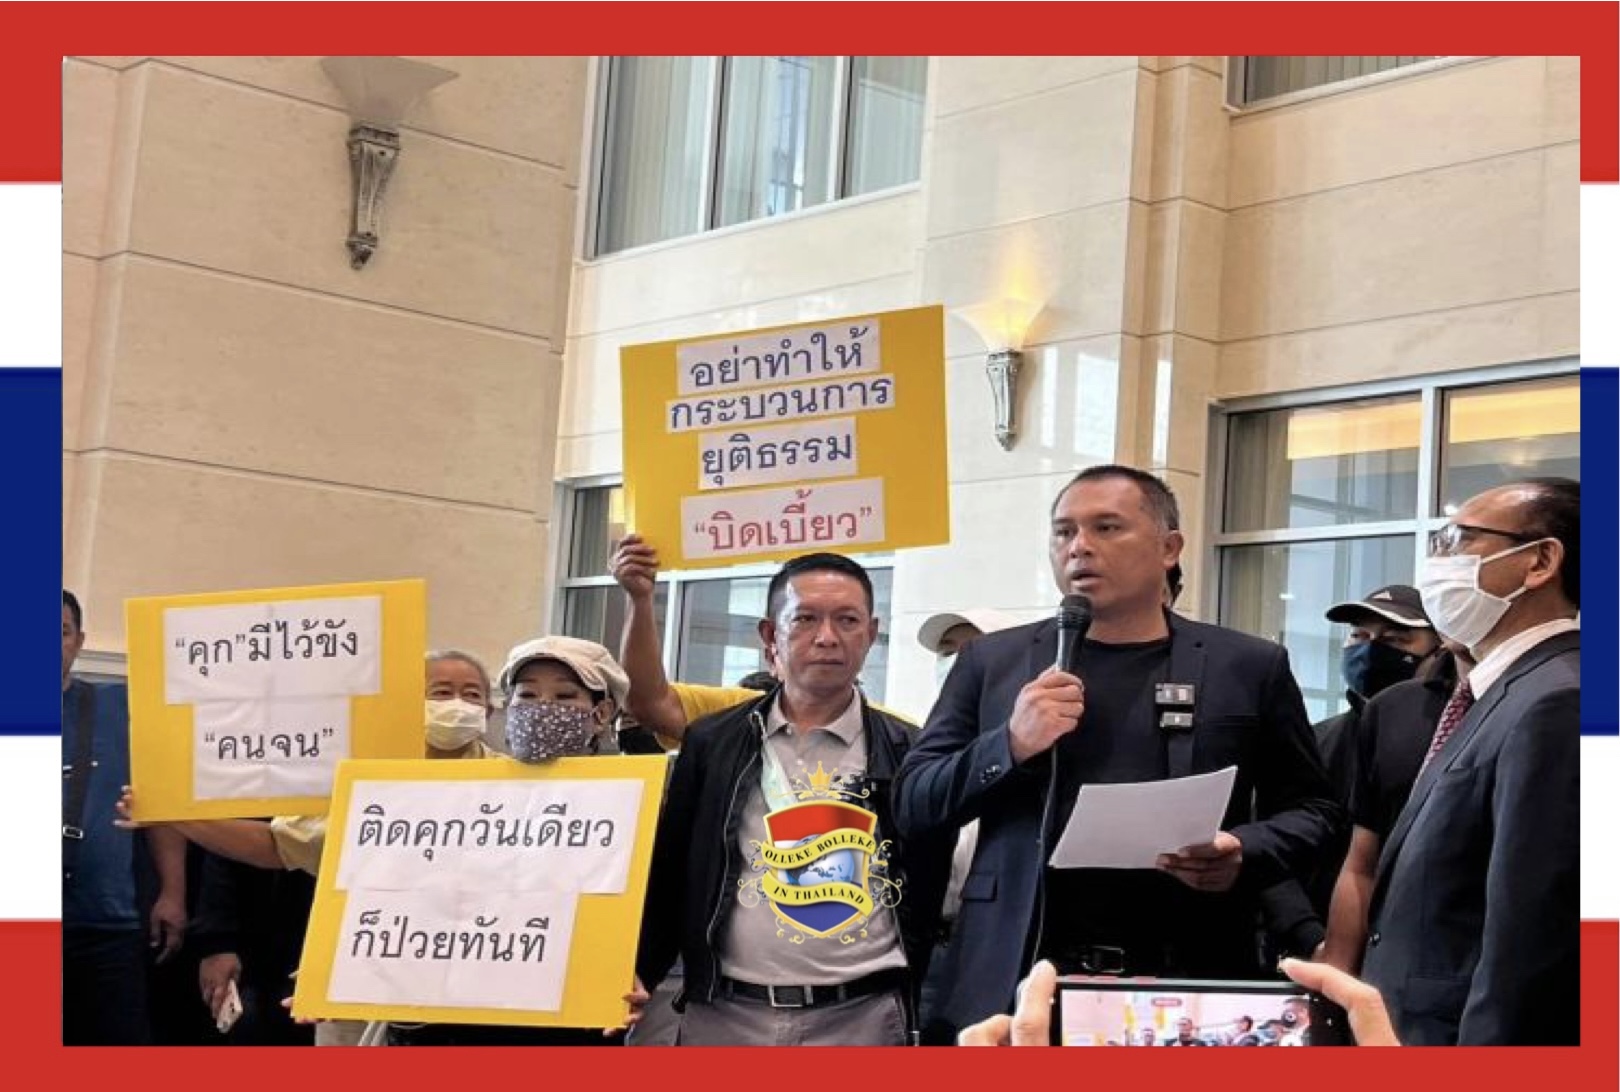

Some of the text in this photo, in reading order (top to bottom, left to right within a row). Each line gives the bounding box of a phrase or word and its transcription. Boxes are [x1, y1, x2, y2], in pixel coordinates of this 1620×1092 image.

[690, 326, 870, 387] อย่าทำให้
[671, 377, 892, 430] กระบวนการ
[702, 433, 852, 485] ยุติธรรม
[695, 488, 873, 550] “บิดเบี้ยว”
[205, 728, 334, 760] “คนจน”
[358, 803, 616, 862] ติดคุกวันเดียว
[351, 909, 550, 963] ก็ป่วยทันที
